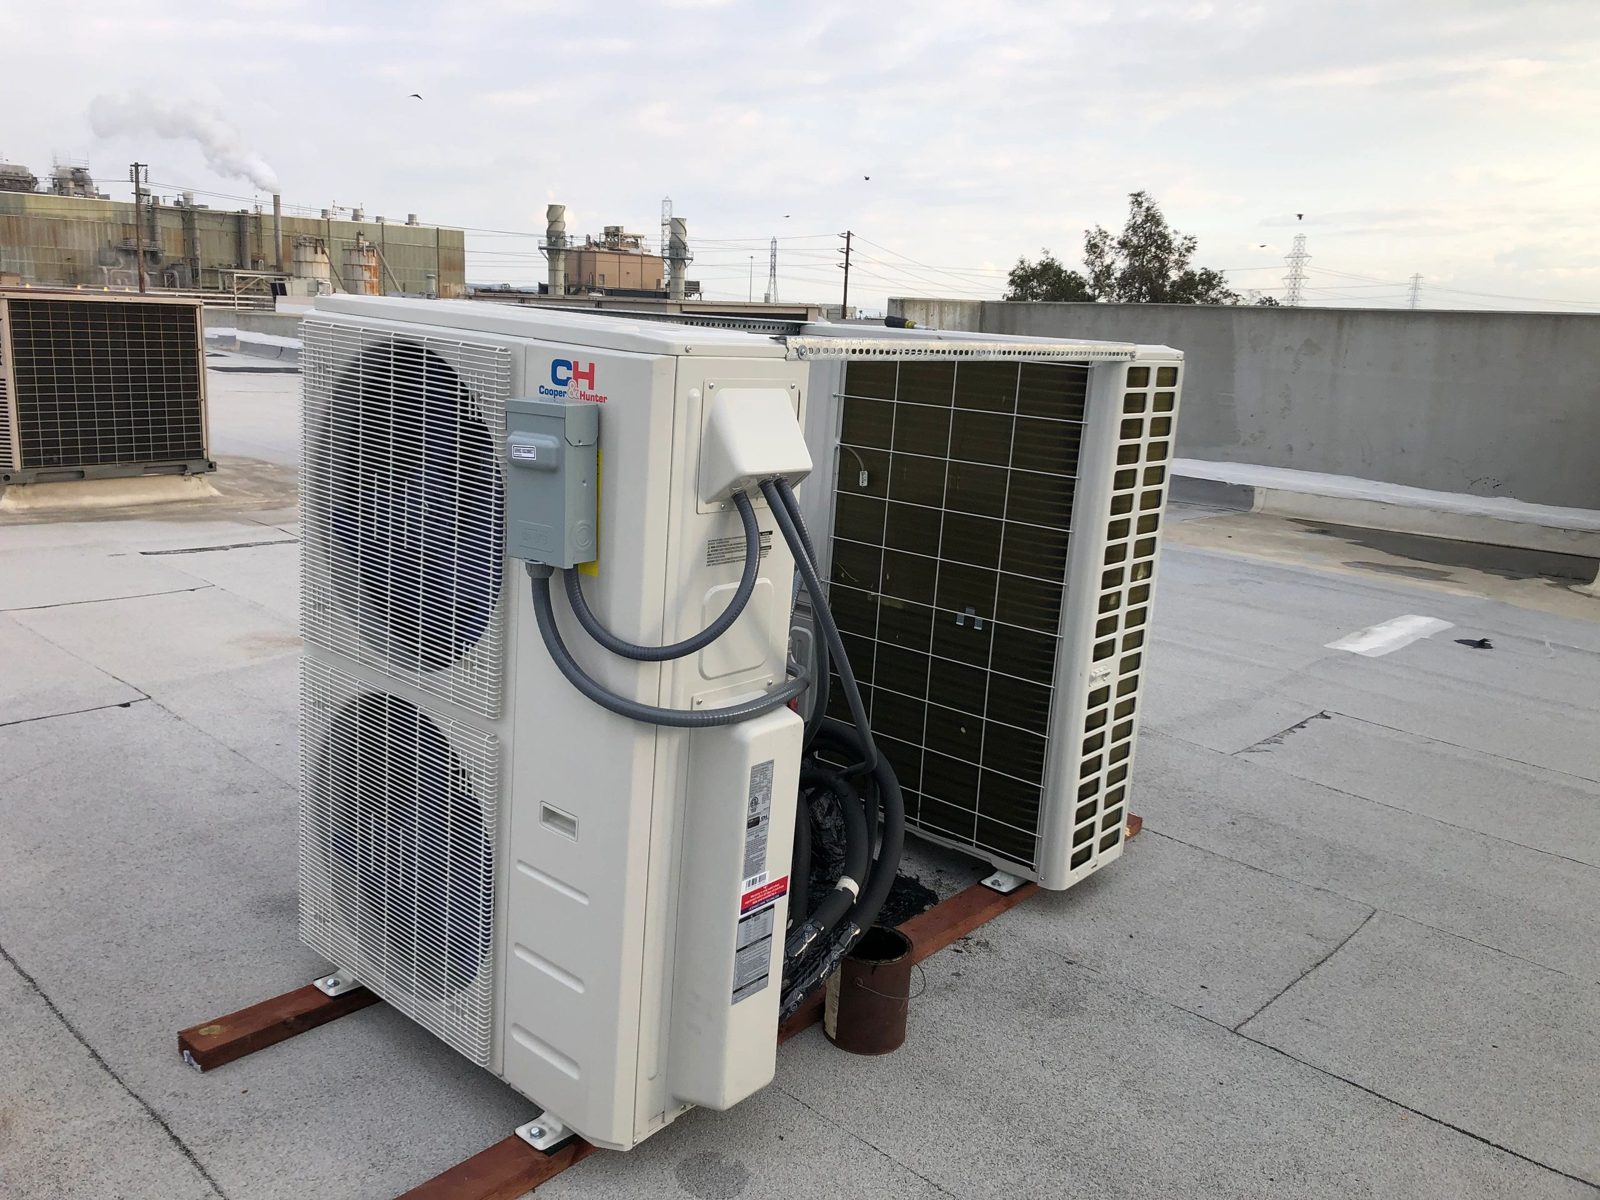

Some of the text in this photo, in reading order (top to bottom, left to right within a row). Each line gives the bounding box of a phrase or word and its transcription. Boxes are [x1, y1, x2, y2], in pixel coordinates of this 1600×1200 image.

[551, 358, 595, 390] CH
[539, 379, 608, 403] Cooper & Hunter
